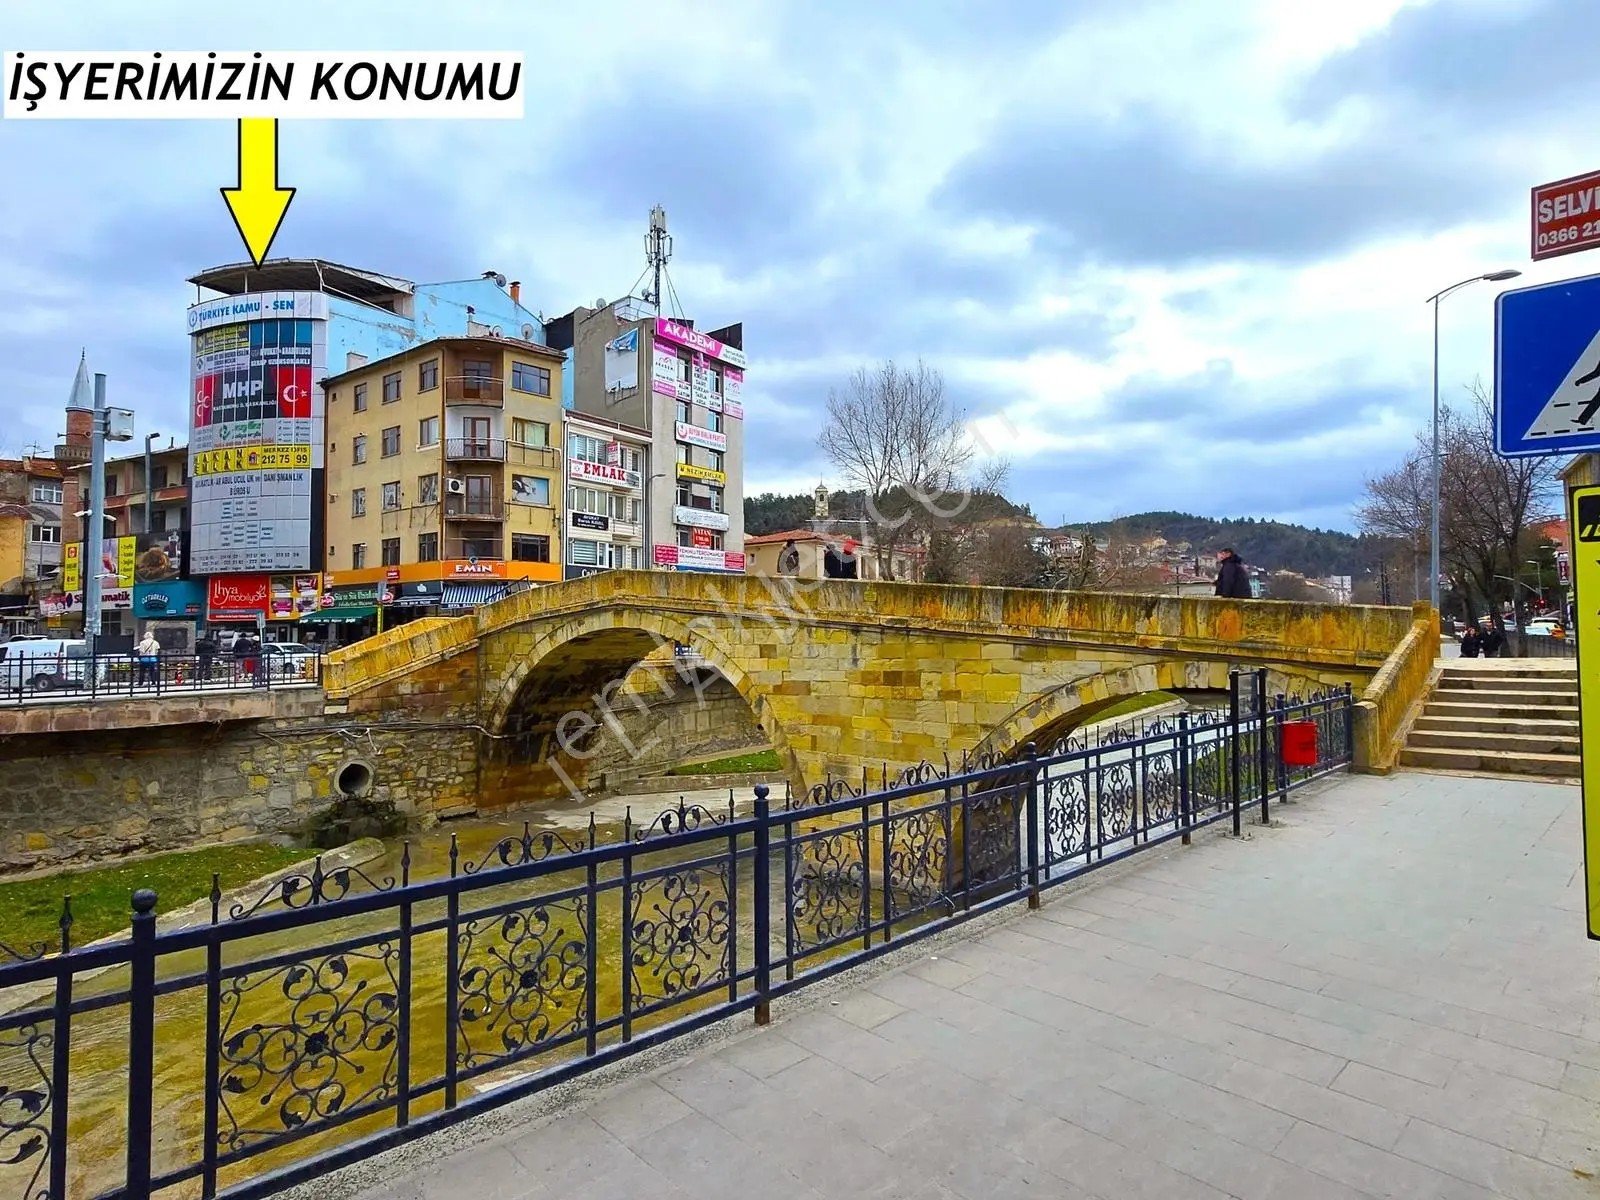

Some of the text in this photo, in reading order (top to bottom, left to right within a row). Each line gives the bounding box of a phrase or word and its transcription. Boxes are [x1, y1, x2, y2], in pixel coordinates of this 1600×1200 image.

[1539, 225, 1578, 247] 0366
[233, 302, 261, 315] KAMU
[273, 300, 294, 310] SEN
[223, 380, 263, 399] MHP
[262, 455, 276, 464] 212
[279, 454, 290, 463] 75
[296, 454, 308, 463] 99
[584, 462, 626, 481] EMLAK
